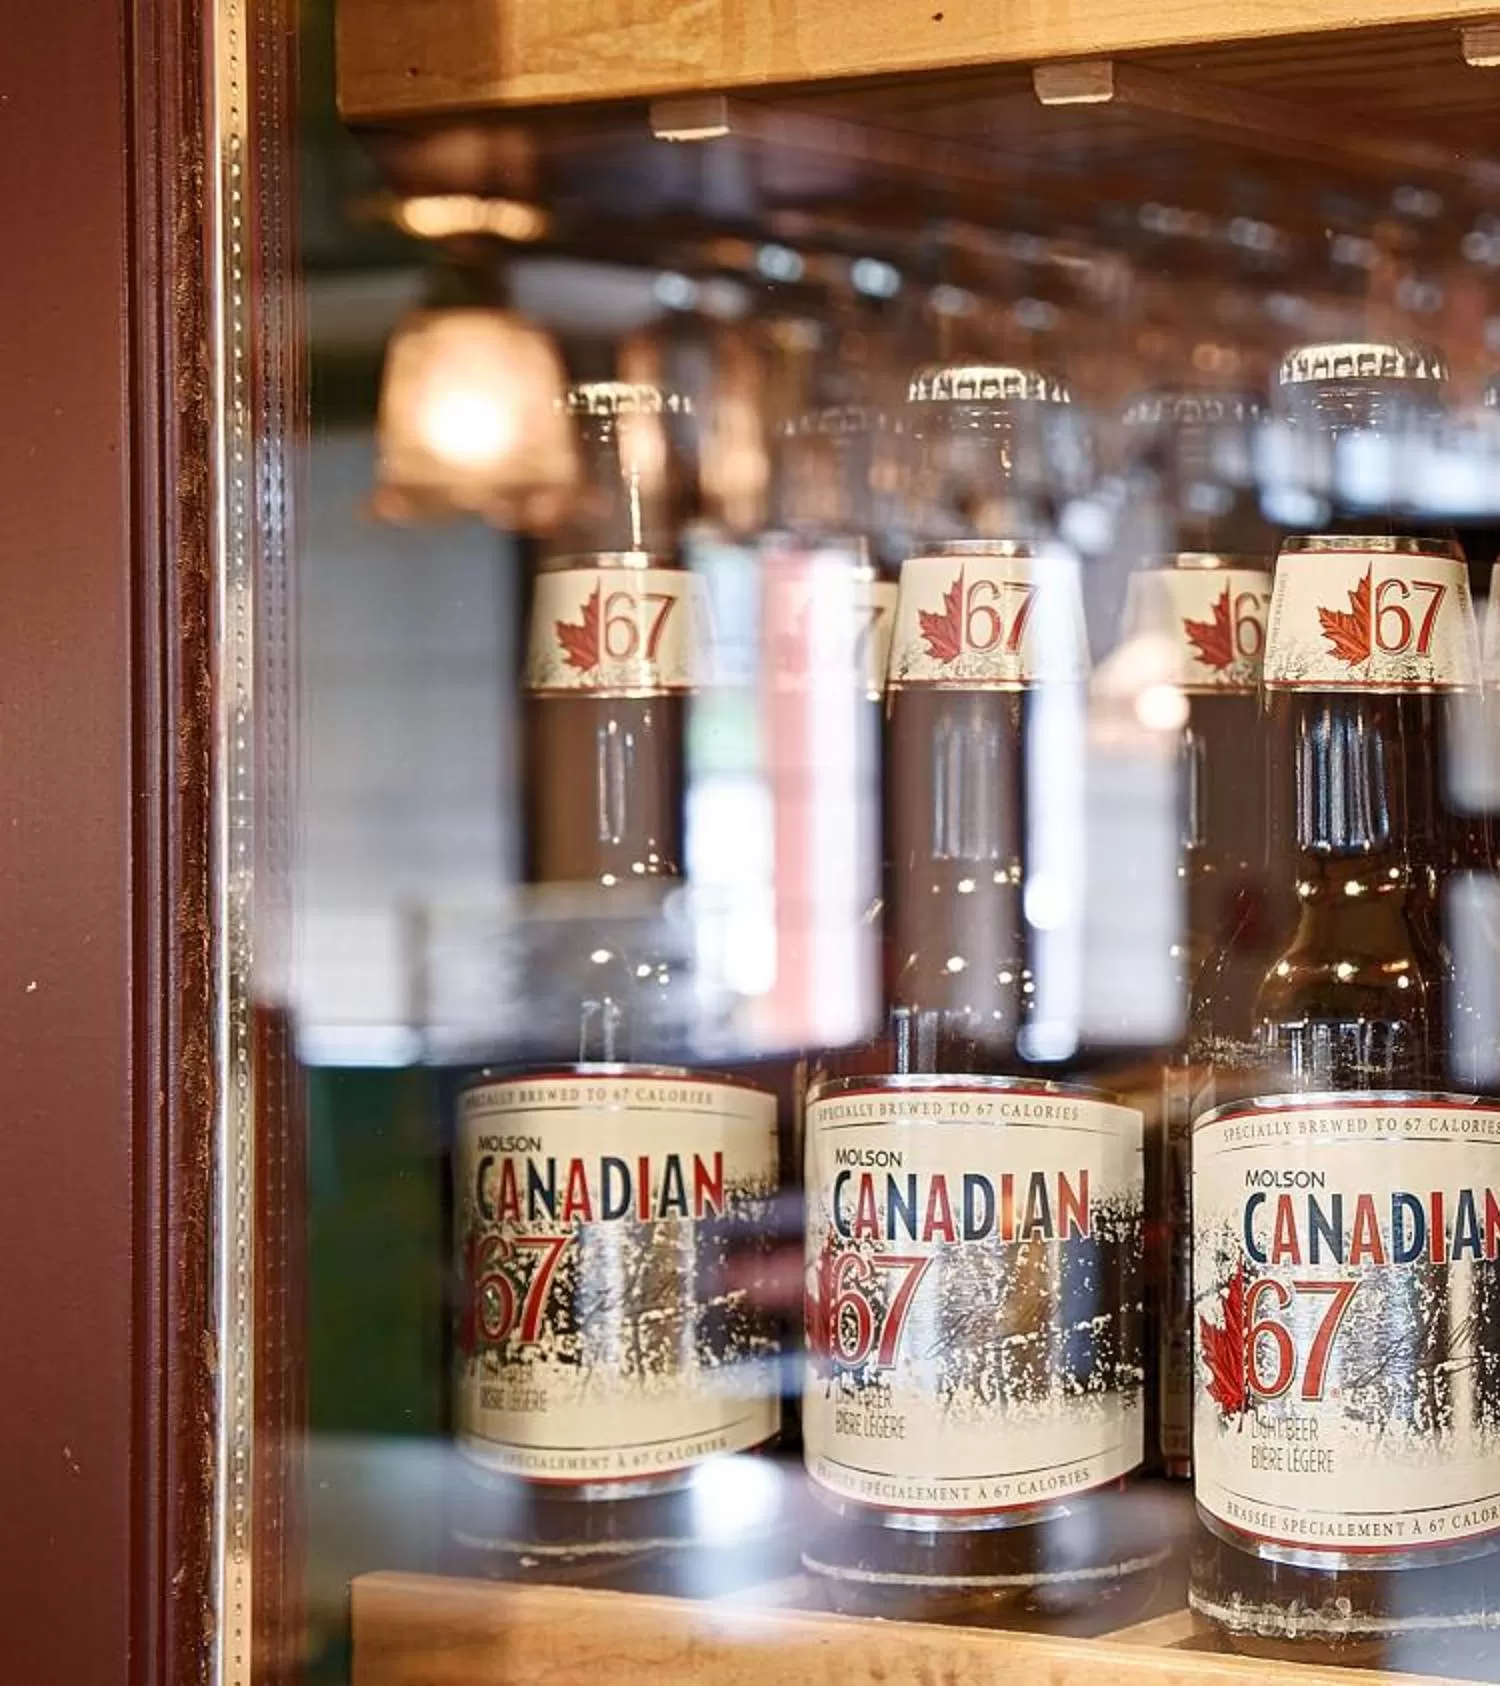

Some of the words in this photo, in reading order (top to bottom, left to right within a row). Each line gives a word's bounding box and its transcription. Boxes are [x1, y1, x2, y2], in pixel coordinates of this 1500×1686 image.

[603, 590, 678, 661] 67
[965, 578, 1041, 655] 67
[1375, 577, 1448, 657] 67
[587, 1087, 606, 1102] TO
[636, 1087, 713, 1105] CALORIES
[880, 1101, 943, 1118] BREWED
[949, 1102, 970, 1117] TO
[976, 1103, 994, 1117] 67
[1000, 1103, 1080, 1121] CALORIES
[477, 1135, 542, 1152] MOLSON
[1223, 1120, 1291, 1142] SPECIALLY
[1299, 1118, 1368, 1134] BREWED
[1375, 1117, 1397, 1132] TO
[1404, 1117, 1421, 1132] 67
[835, 1148, 903, 1168] MOLSON
[475, 1152, 724, 1223] CANADIAN
[1245, 1169, 1325, 1188] MOLSON
[832, 1169, 1094, 1243] CANADIAN
[474, 1234, 568, 1345] 67
[829, 1251, 935, 1371] 67
[1243, 1277, 1363, 1403] 67
[1286, 1416, 1320, 1441] BEER
[977, 1480, 989, 1499] À
[994, 1483, 1012, 1498] 67
[1017, 1467, 1091, 1495] CALORIES
[1281, 1515, 1404, 1538] SPÉCIALEMENT
[1411, 1515, 1423, 1535] À
[1429, 1517, 1446, 1534] 67
